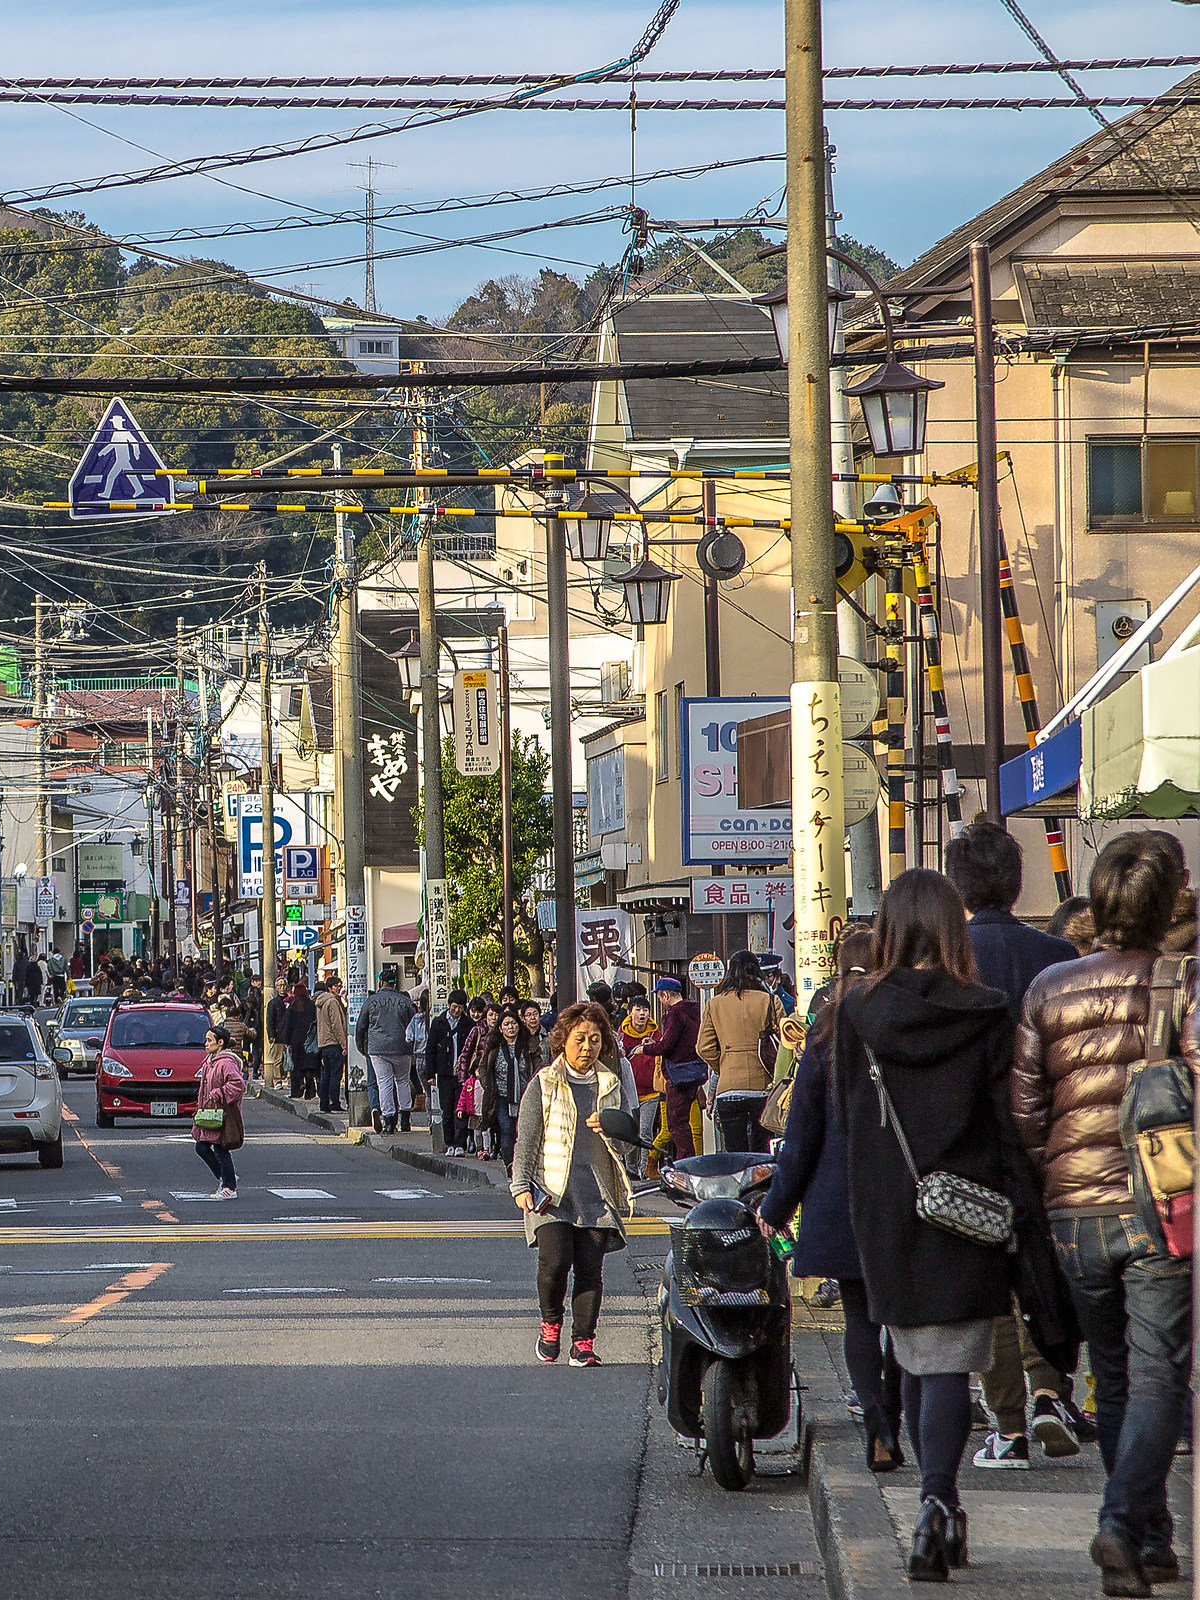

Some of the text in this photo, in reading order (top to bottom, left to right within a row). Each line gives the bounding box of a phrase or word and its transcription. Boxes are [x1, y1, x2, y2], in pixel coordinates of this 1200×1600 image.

[478, 690, 487, 743] 総合住宅展示場
[464, 718, 474, 757] プラザ大船
[367, 733, 408, 803] まめや
[227, 784, 243, 793] 24h
[711, 840, 738, 850] OPEN
[290, 850, 313, 878] P
[300, 869, 314, 878] 入口
[290, 886, 314, 895] 空車
[286, 905, 303, 921] 空
[303, 932, 315, 944] P
[434, 897, 448, 1000] 鎌倉ハム富岡商会
[580, 918, 627, 970] 栗
[349, 936, 357, 974] クリニック
[692, 962, 721, 970] 長谷駅
